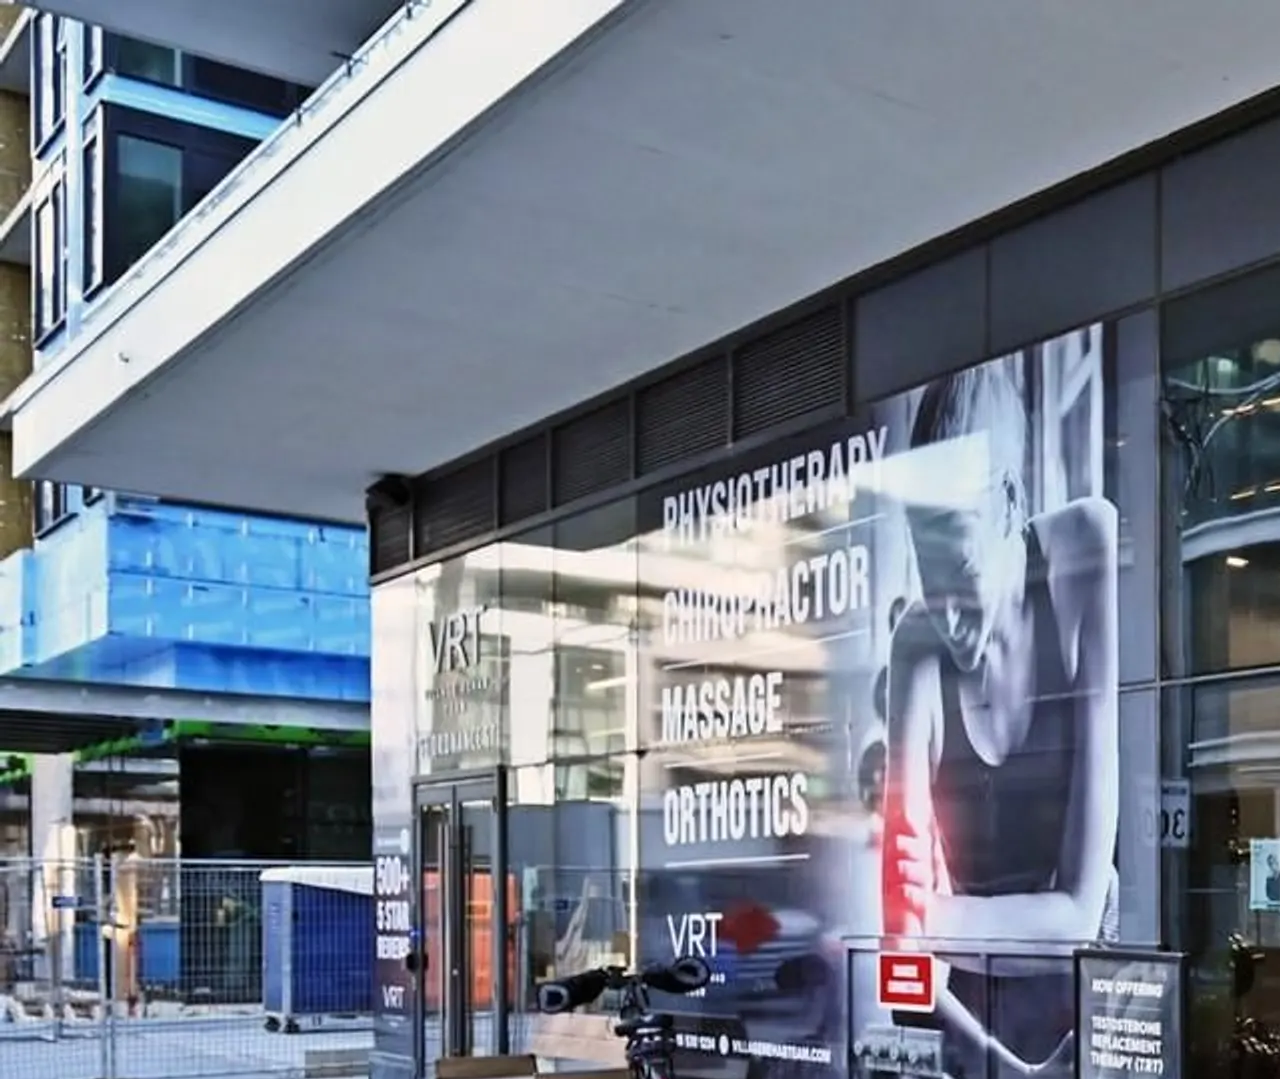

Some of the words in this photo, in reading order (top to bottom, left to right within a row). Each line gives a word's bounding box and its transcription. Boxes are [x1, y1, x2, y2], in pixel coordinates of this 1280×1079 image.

[663, 425, 888, 549] PHYSIOTHERAPY
[663, 544, 870, 646] CHIROPRACTOR
[428, 603, 487, 674] VRT
[662, 671, 784, 743] MASSAGE
[663, 772, 809, 846] ORTHOTICS
[376, 855, 411, 896] 500+
[667, 911, 724, 959] VRT
[382, 984, 406, 1009] VRT
[1134, 1056, 1164, 1075] (TRT)
